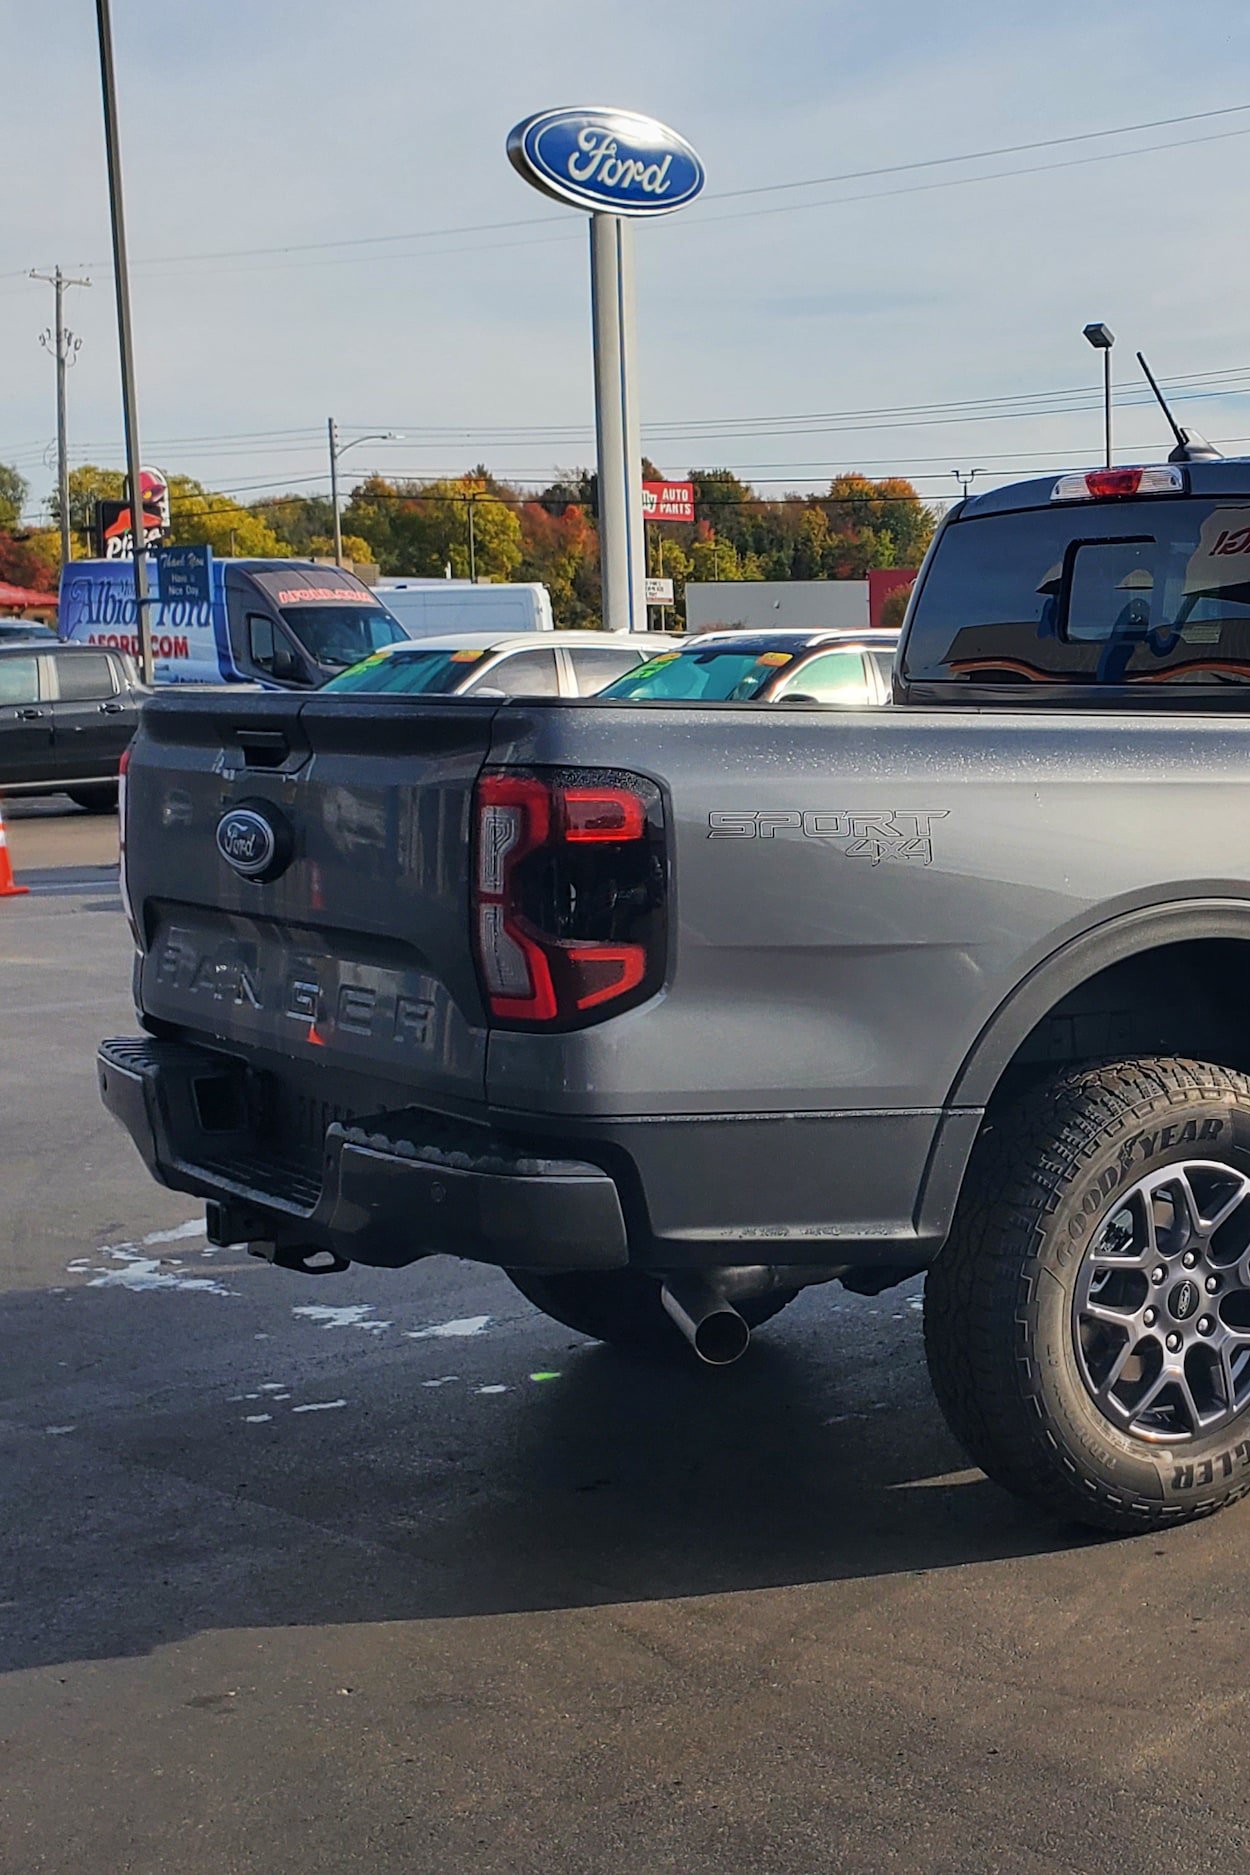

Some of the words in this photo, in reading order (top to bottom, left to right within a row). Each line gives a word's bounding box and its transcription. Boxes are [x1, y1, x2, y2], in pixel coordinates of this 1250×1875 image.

[568, 127, 672, 195] Ford
[662, 488, 689, 501] AUTO
[660, 503, 692, 515] PARTS
[169, 586, 183, 595] Nice
[186, 585, 199, 597] Day
[88, 634, 189, 659] AFORDCOM
[707, 810, 950, 838] SPORT
[225, 822, 256, 857] Ford
[156, 942, 437, 1048] RANGER
[1056, 1118, 1224, 1268] GOODYEAR
